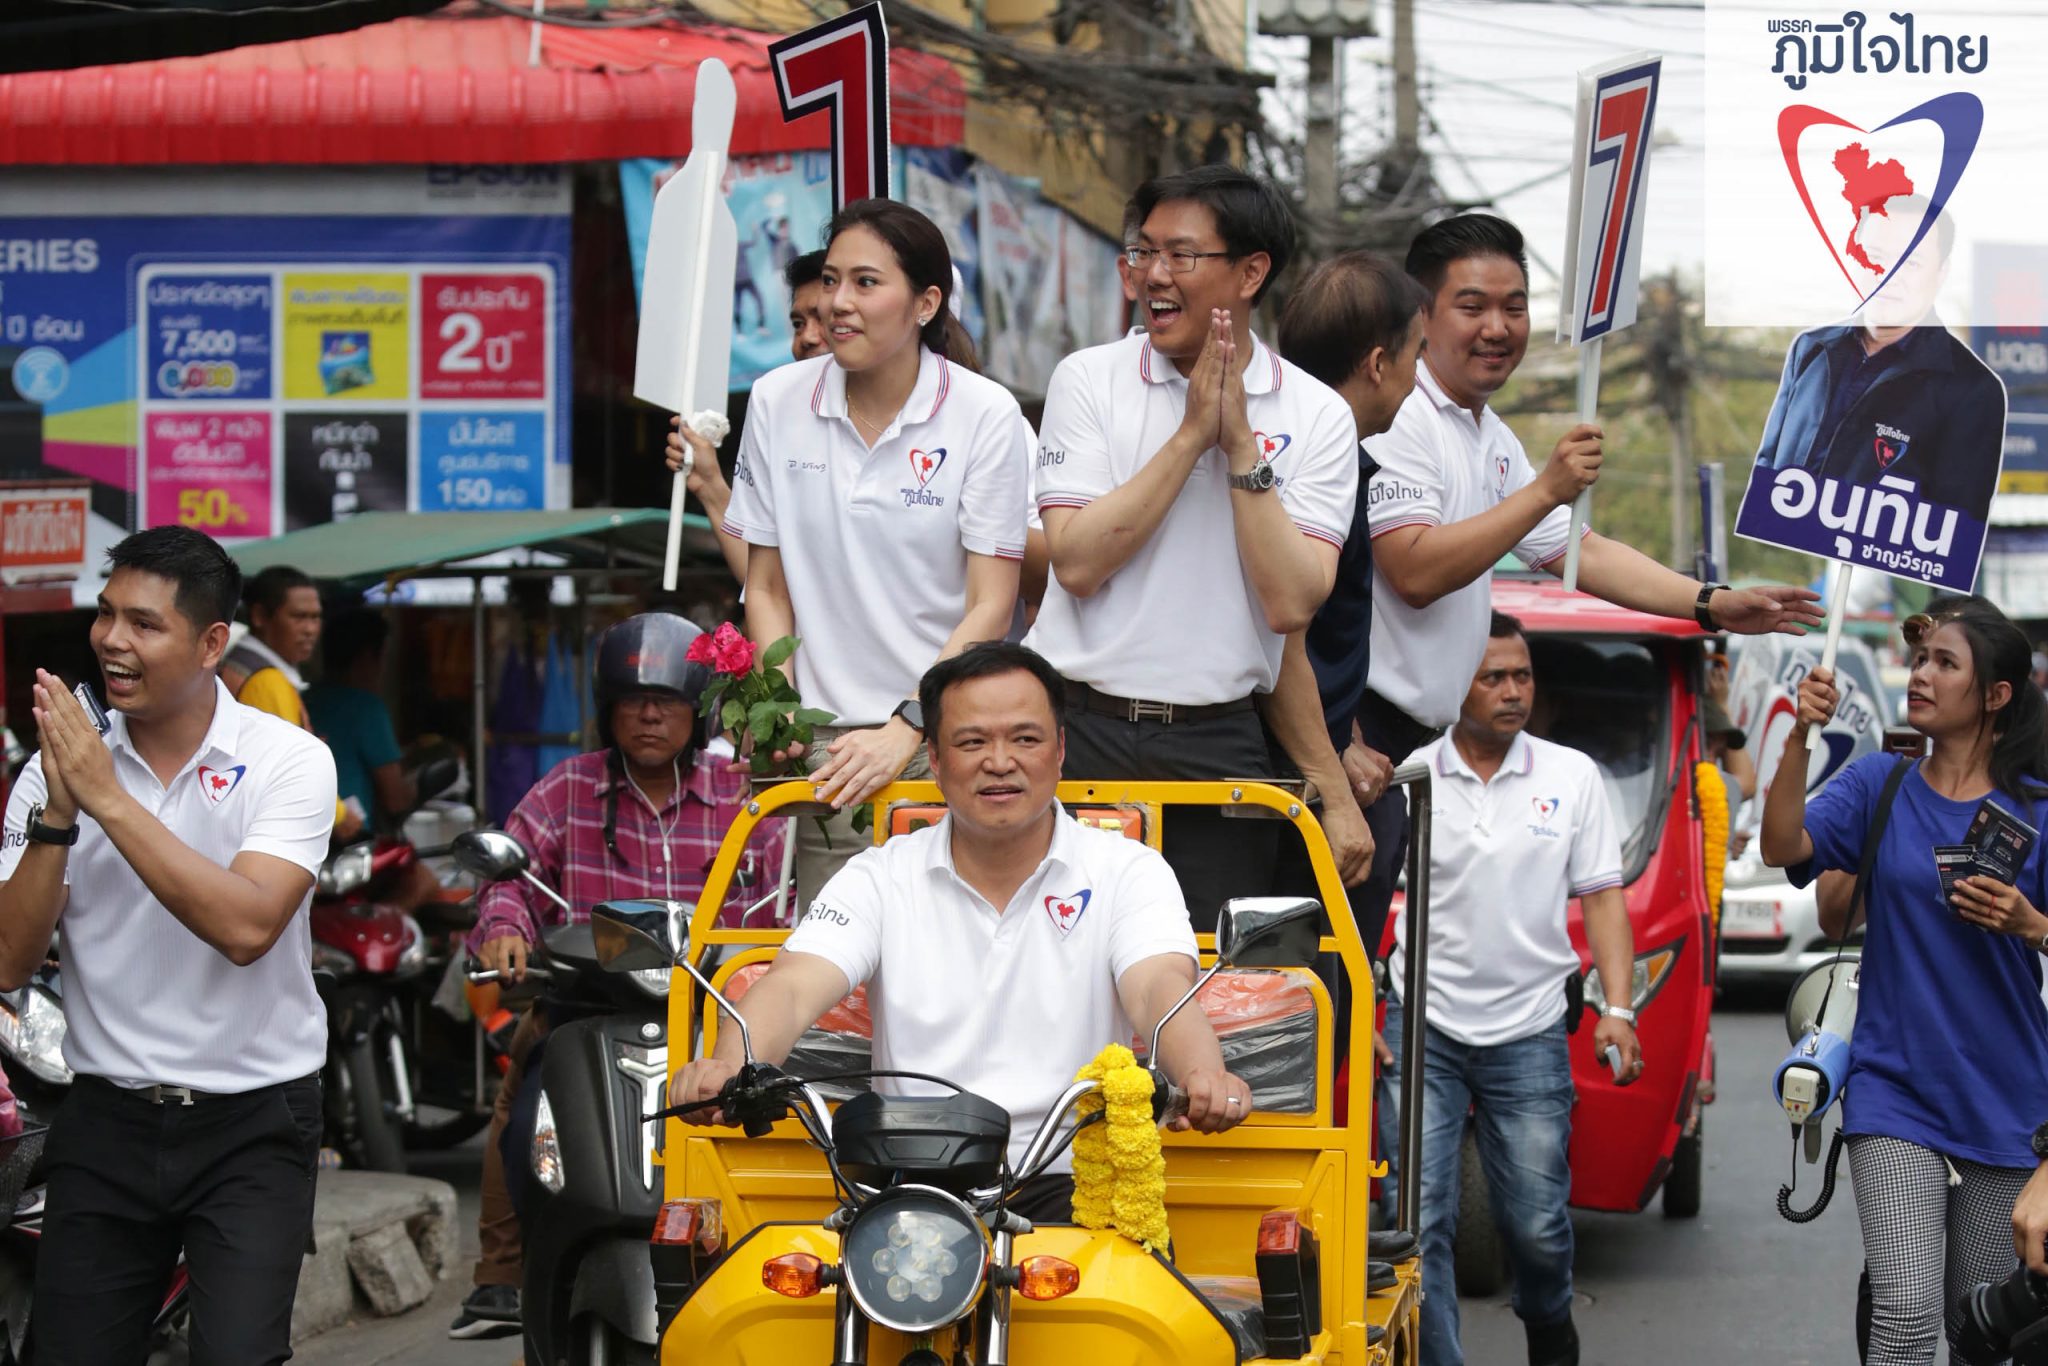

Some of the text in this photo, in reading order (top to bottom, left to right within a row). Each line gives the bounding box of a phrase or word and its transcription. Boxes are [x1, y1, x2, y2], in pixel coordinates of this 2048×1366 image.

[1580, 60, 1662, 342] 7
[0, 239, 98, 272] RIES
[160, 329, 237, 359] 7,500
[437, 312, 484, 373] 2
[178, 488, 249, 527] 50%
[438, 478, 493, 505] 150
[1770, 467, 1959, 558] อนุทิน
[1862, 543, 1945, 581] ชาญวีรกูล
